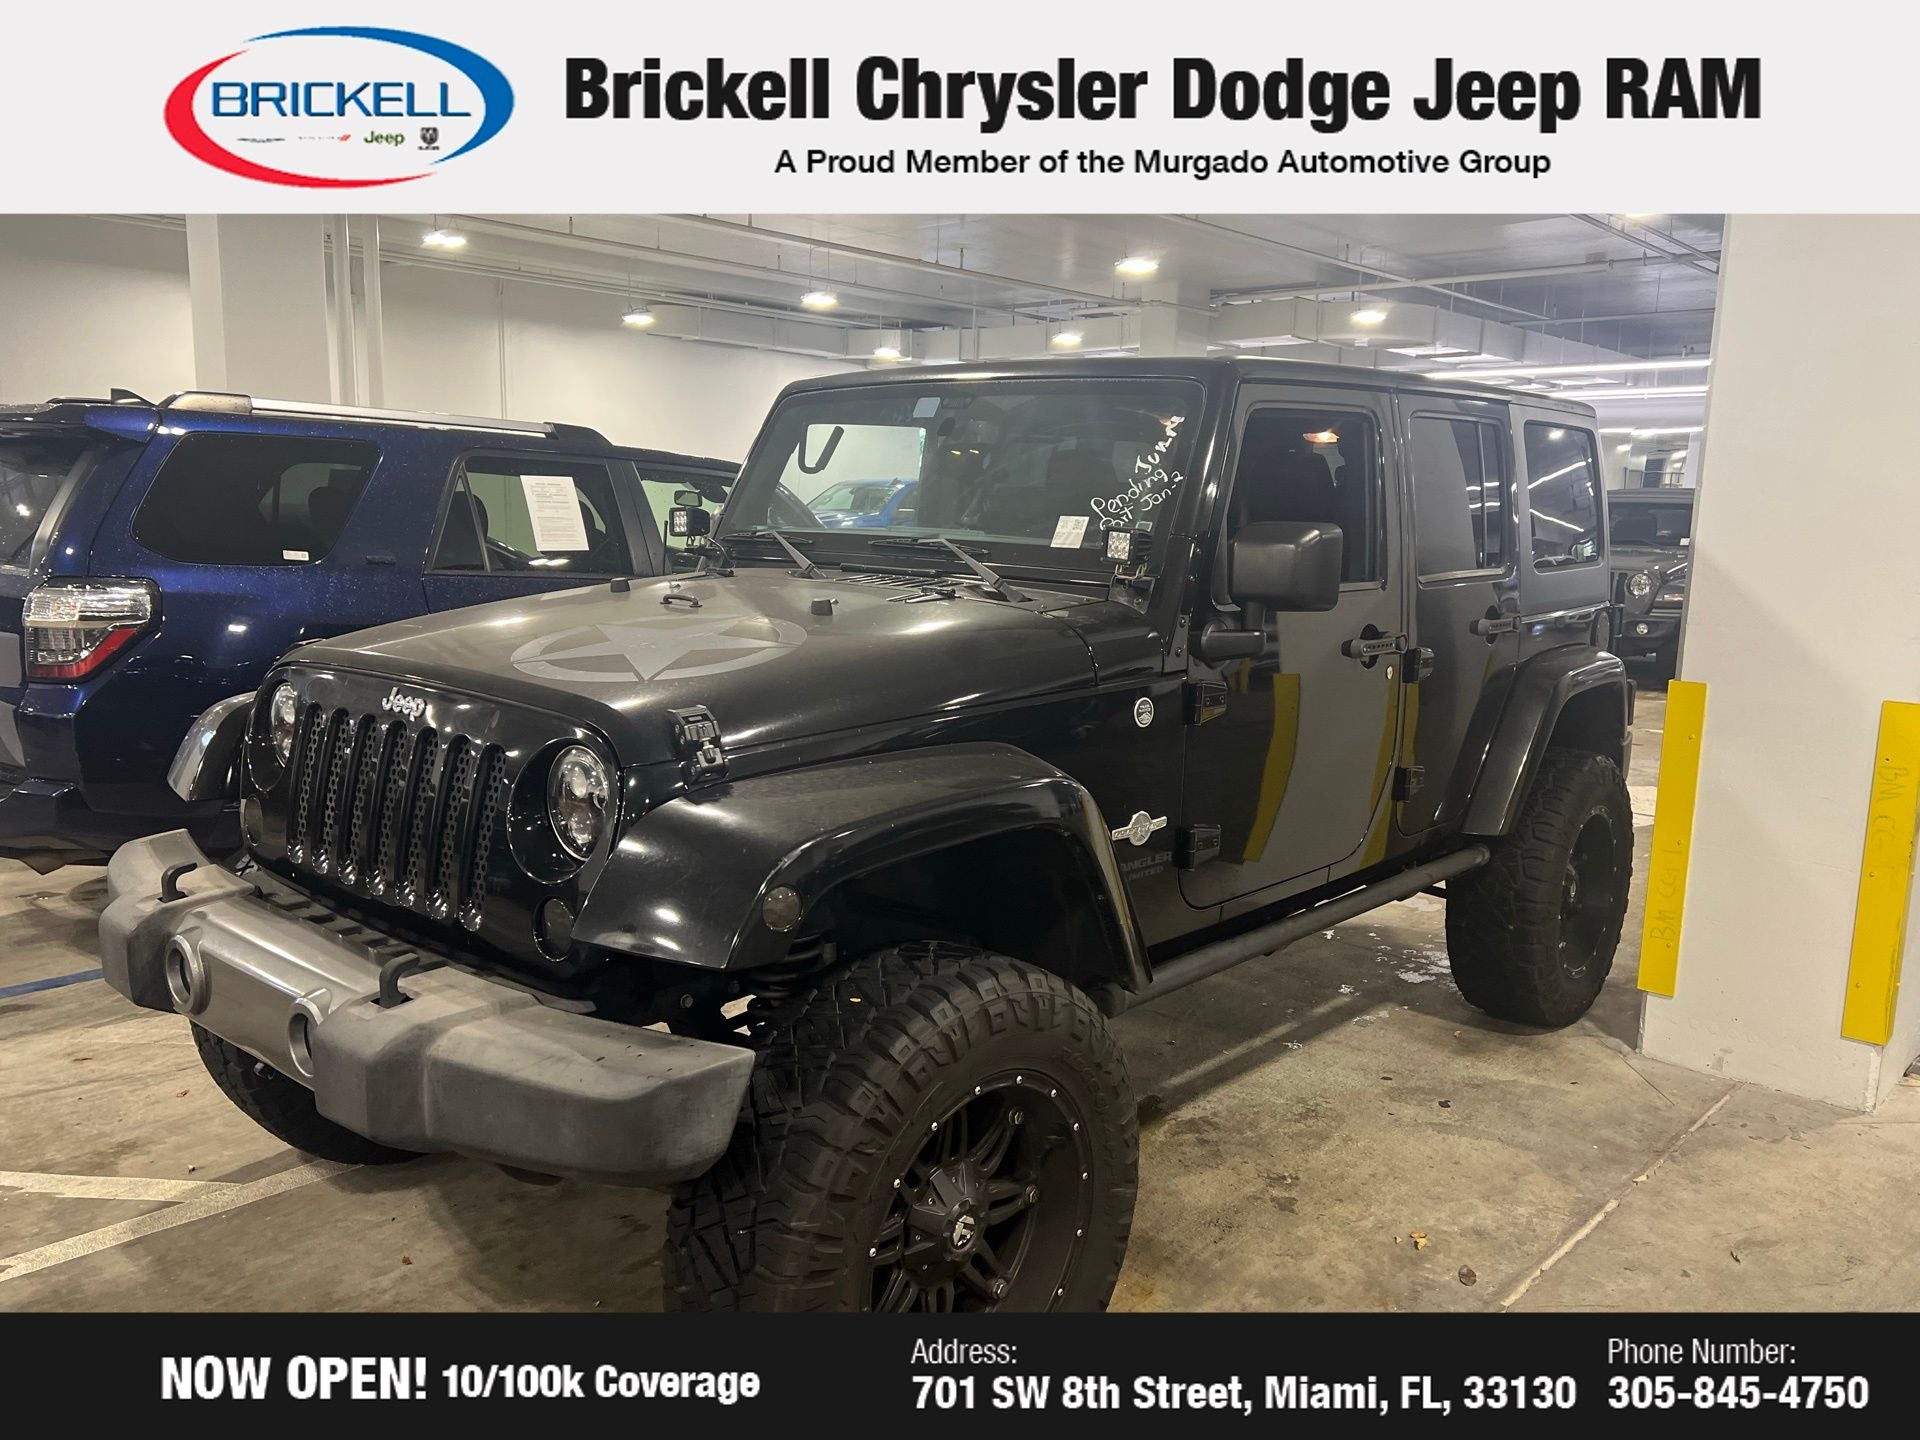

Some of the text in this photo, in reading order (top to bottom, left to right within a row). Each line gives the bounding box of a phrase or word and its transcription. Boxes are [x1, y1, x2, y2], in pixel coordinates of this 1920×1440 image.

[1091, 468, 1168, 519] Pending
[1140, 471, 1184, 511] Jan-2
[381, 687, 426, 722] Jeep
[1120, 851, 1173, 872] ANGLER
